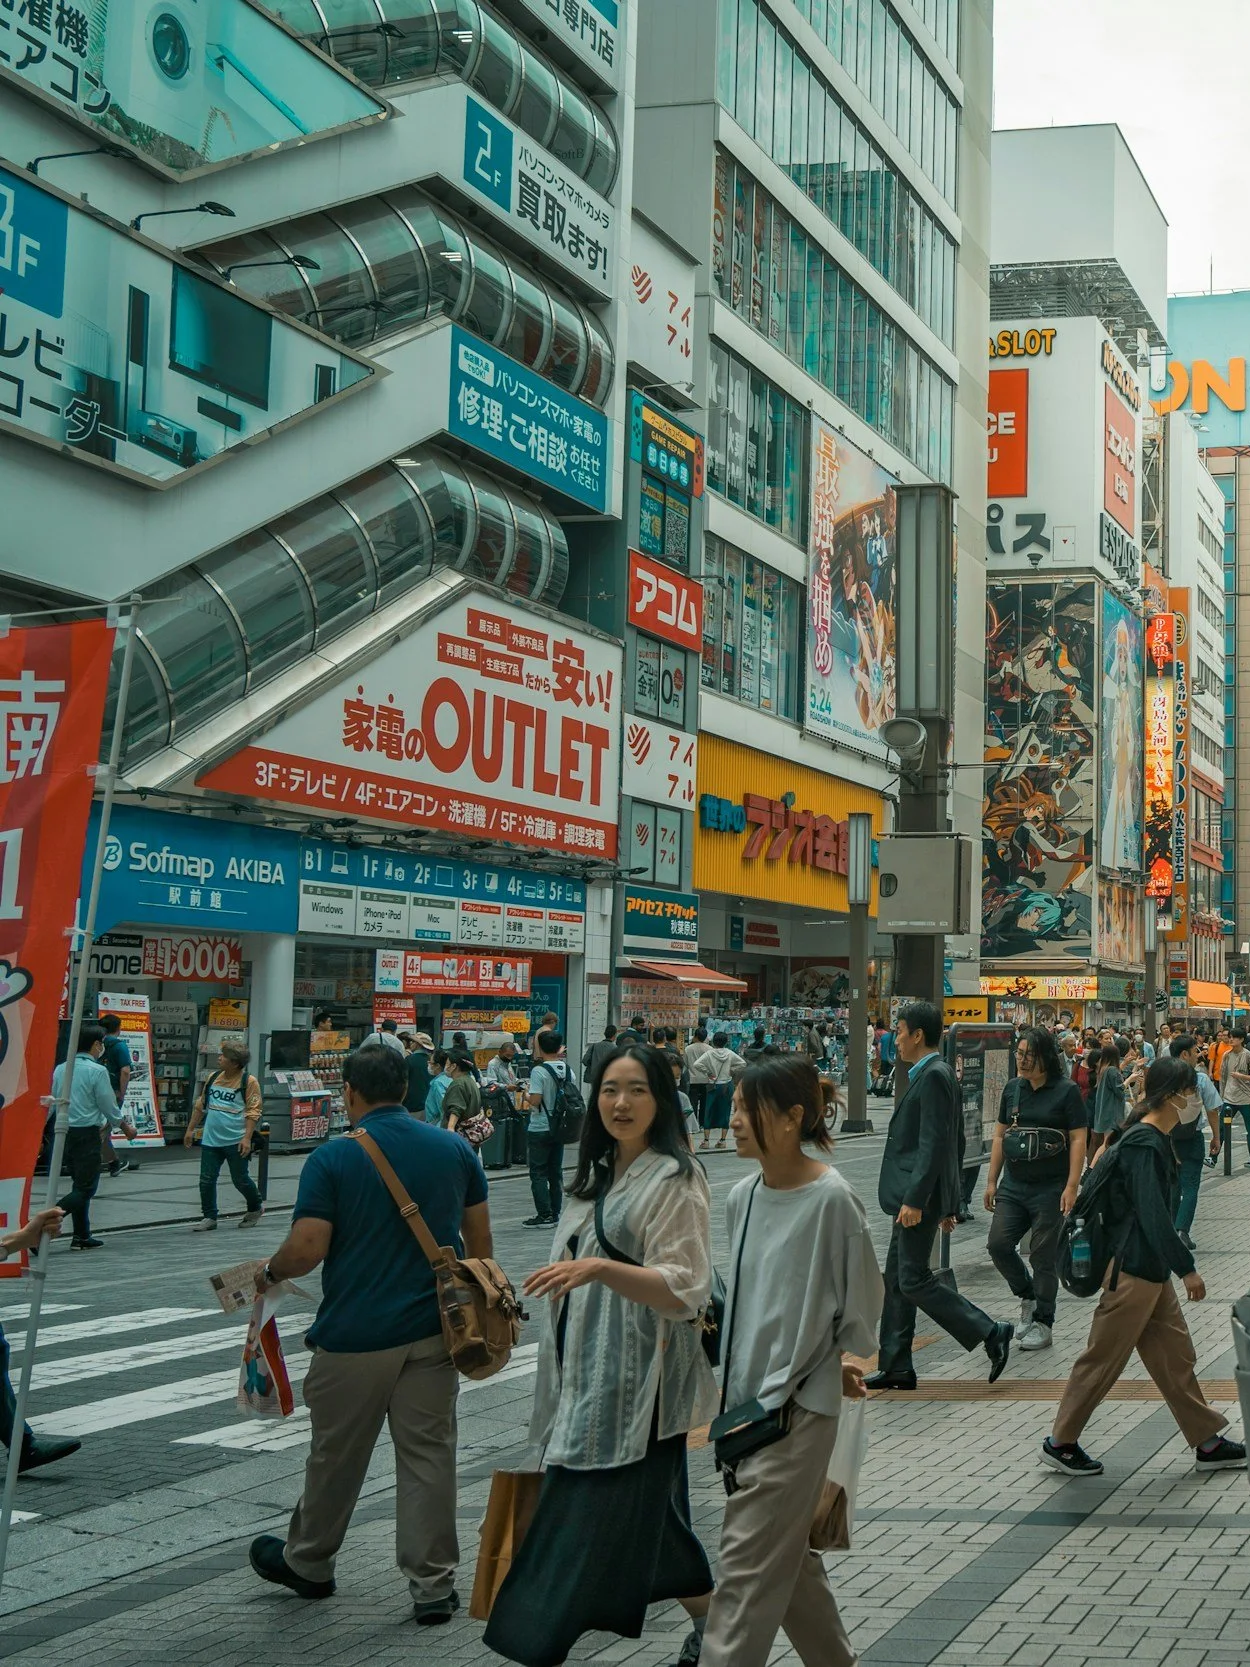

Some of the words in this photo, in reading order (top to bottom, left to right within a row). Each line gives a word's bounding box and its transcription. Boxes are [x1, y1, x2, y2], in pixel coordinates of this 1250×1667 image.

[0, 0, 88, 58] 濯機
[474, 121, 502, 187] 2F
[518, 146, 610, 229] パソコン・スマホ・カメラ
[496, 370, 602, 447] パソコン・スマホ・家電の
[457, 381, 568, 476] 修理・ご相談
[570, 445, 600, 476] お任せ
[571, 468, 600, 493] ください
[636, 567, 697, 636] アコム
[478, 618, 501, 637] 展示品
[810, 683, 832, 715] 5.24
[421, 677, 610, 806] OUTLET
[129, 841, 215, 884] Sofmap
[225, 857, 285, 885] AKIBA
[305, 849, 323, 872] B1
[363, 855, 378, 878] 1F
[414, 863, 431, 885] 2F
[462, 870, 478, 890] 3F
[507, 876, 522, 896] 4F
[549, 882, 562, 901] 5F
[311, 902, 344, 915] Windows
[427, 913, 440, 924] Mac
[626, 897, 698, 920] アクセスチケット
[363, 922, 382, 933] カメラ
[461, 916, 478, 928] テレビ
[460, 931, 488, 940] レコーダー
[505, 934, 527, 945] エアコン
[88, 953, 142, 975] hone
[381, 960, 399, 969] OUTLET
[408, 958, 419, 974] 4F
[481, 963, 491, 977] 5F
[379, 977, 399, 987] Sofmap
[120, 999, 131, 1007] TAX
[131, 999, 145, 1007] FREE
[460, 1012, 480, 1021] SUPER
[480, 1013, 494, 1022] SALE
[292, 1117, 330, 1141] 話題作
